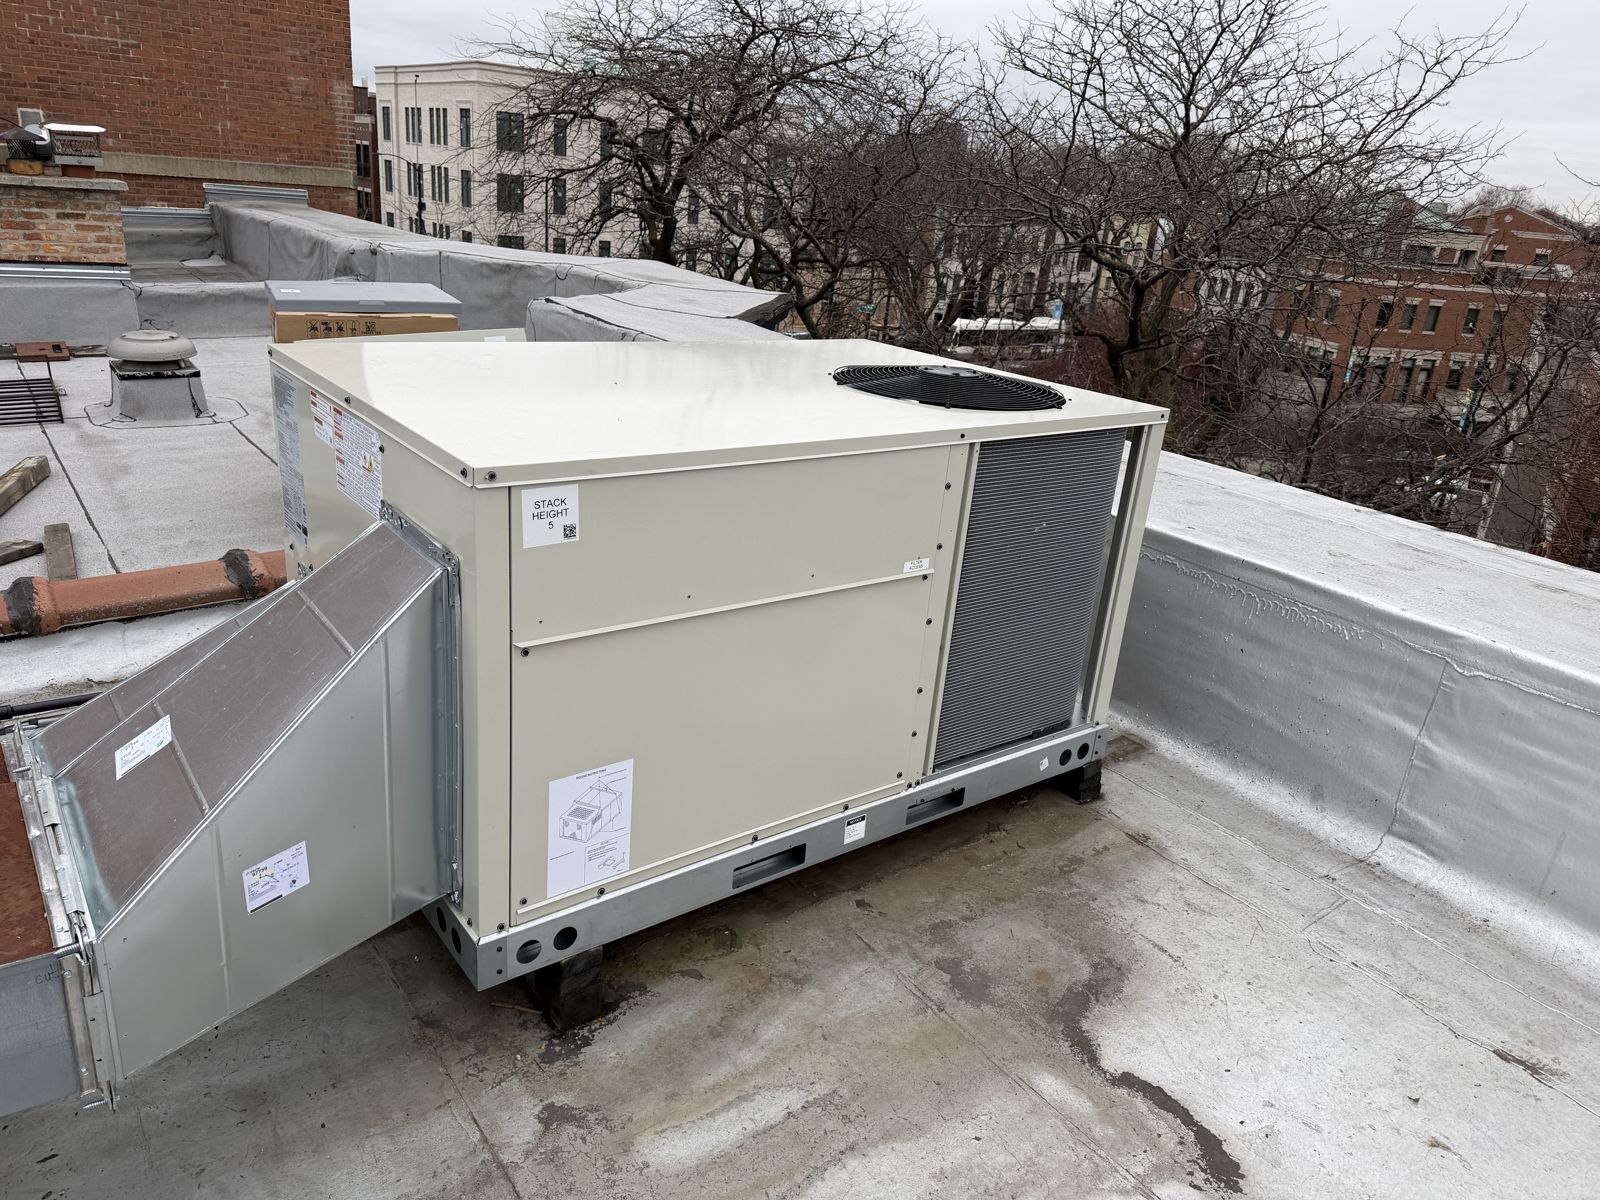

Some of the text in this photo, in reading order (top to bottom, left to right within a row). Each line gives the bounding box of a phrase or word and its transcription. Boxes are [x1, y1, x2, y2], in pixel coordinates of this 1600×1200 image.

[534, 497, 567, 510] STACK
[532, 508, 569, 520] HEIGHT
[548, 521, 554, 529] 5
